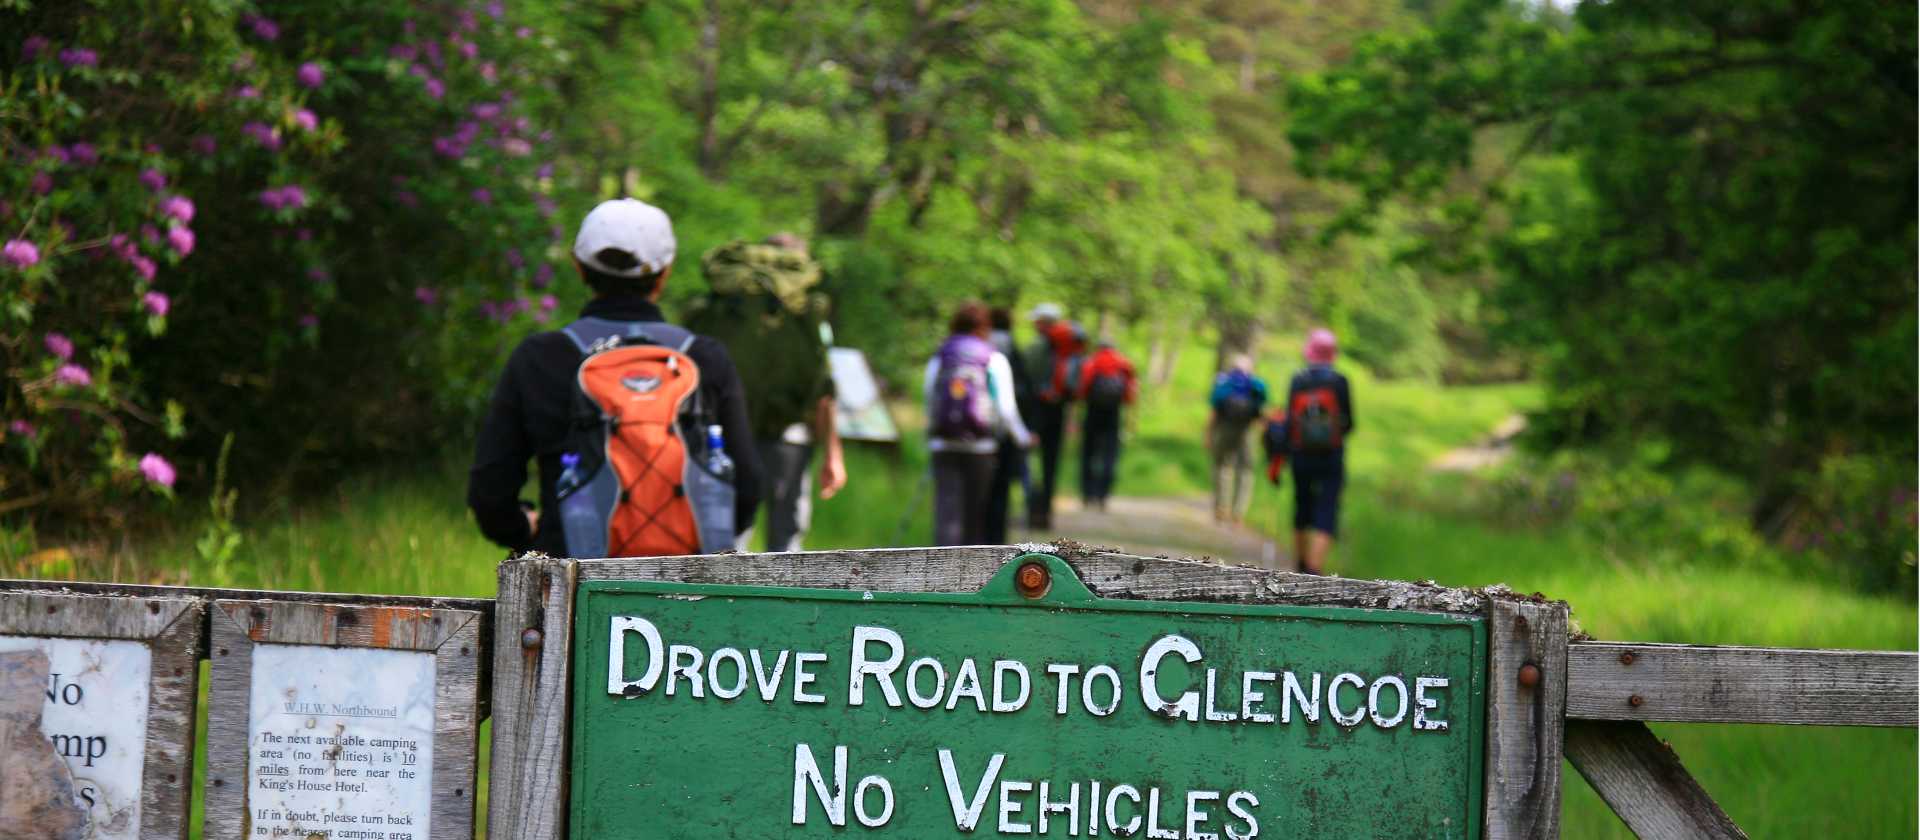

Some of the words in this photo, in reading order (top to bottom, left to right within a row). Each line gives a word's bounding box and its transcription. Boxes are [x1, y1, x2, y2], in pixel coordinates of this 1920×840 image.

[607, 615, 828, 703] DROVE
[849, 626, 1031, 712] ROAD
[1047, 664, 1122, 716] TO
[1140, 635, 1449, 731] GLENCOE
[283, 702, 329, 715] W.H.W.
[331, 703, 397, 718] Northbound
[261, 731, 282, 743] The
[287, 735, 311, 745] next
[315, 735, 365, 746] available
[370, 737, 417, 751] camping
[260, 750, 283, 759] area
[293, 749, 312, 761] (no
[322, 749, 373, 766] failities)
[383, 752, 392, 763] is
[402, 751, 416, 765] 10
[258, 763, 289, 777] miles
[299, 764, 324, 776] from
[334, 765, 357, 777] here
[366, 768, 390, 778] near
[398, 768, 416, 779] the
[259, 778, 294, 792] King's
[297, 779, 332, 791] House
[335, 781, 368, 793] Hotel.
[792, 743, 895, 828] NO
[937, 748, 1261, 840] VEHICLES
[256, 808, 268, 820] If
[271, 809, 281, 820] in
[323, 811, 358, 824] please
[361, 815, 383, 824] turn
[387, 814, 412, 825] back
[256, 826, 268, 835] to
[272, 825, 289, 836] the
[338, 828, 384, 840] camping
[389, 832, 412, 840] area
